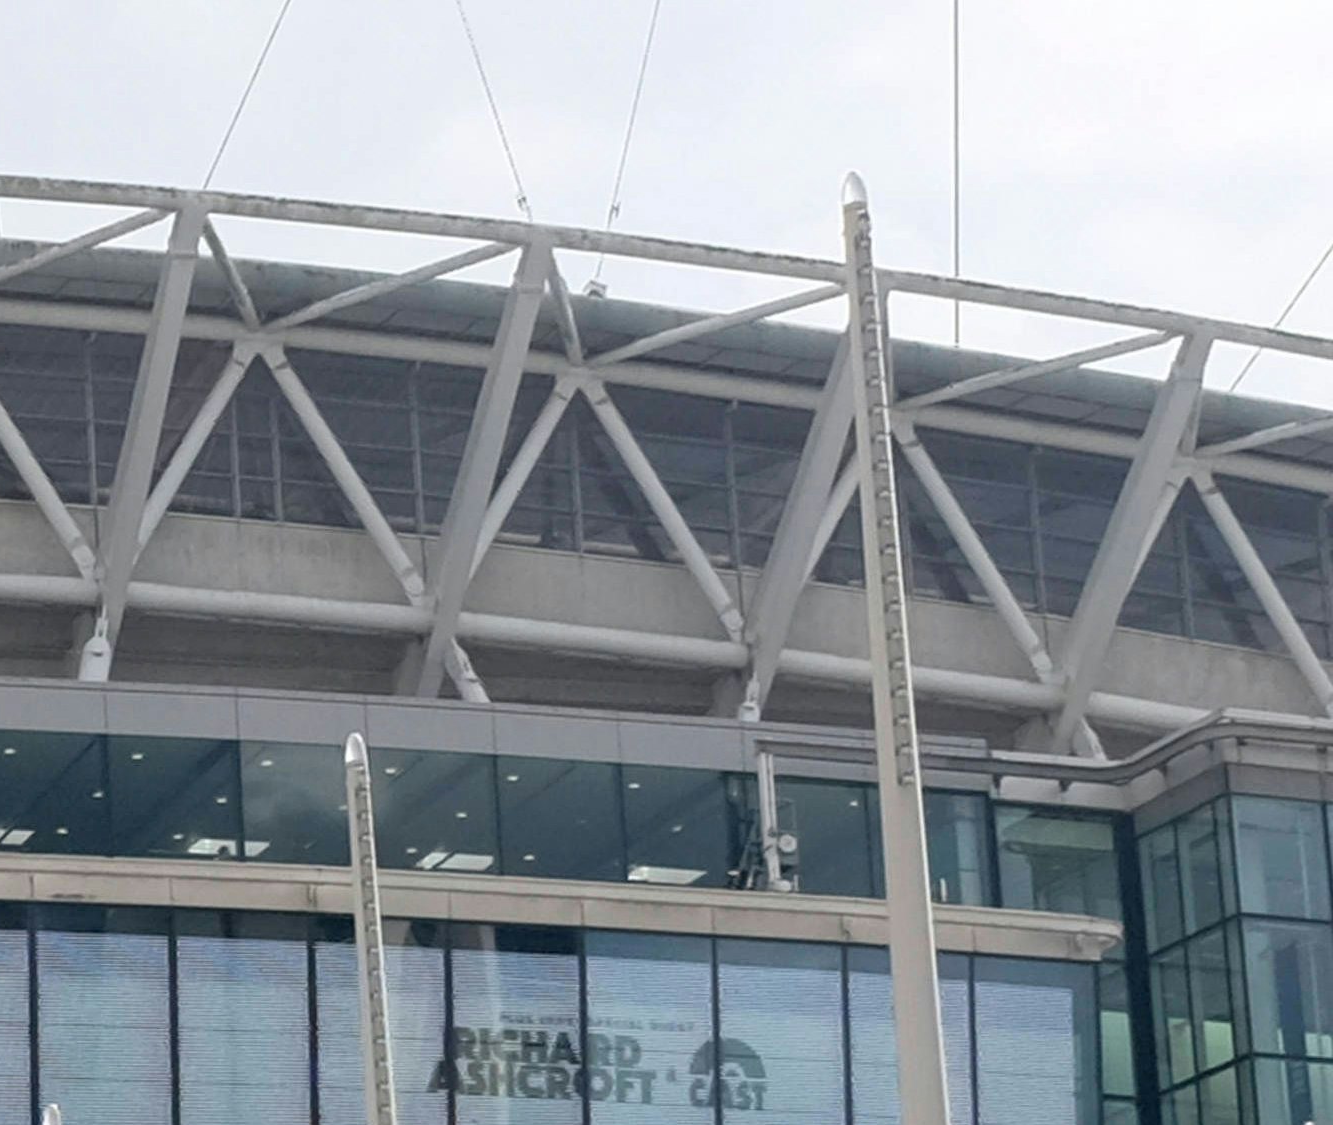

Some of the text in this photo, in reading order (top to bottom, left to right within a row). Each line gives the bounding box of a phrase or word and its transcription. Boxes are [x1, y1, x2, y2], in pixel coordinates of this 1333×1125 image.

[450, 1027, 642, 1067] RICHARD
[427, 1059, 657, 1104] ASHCROFT
[689, 1077, 767, 1111] CAST
